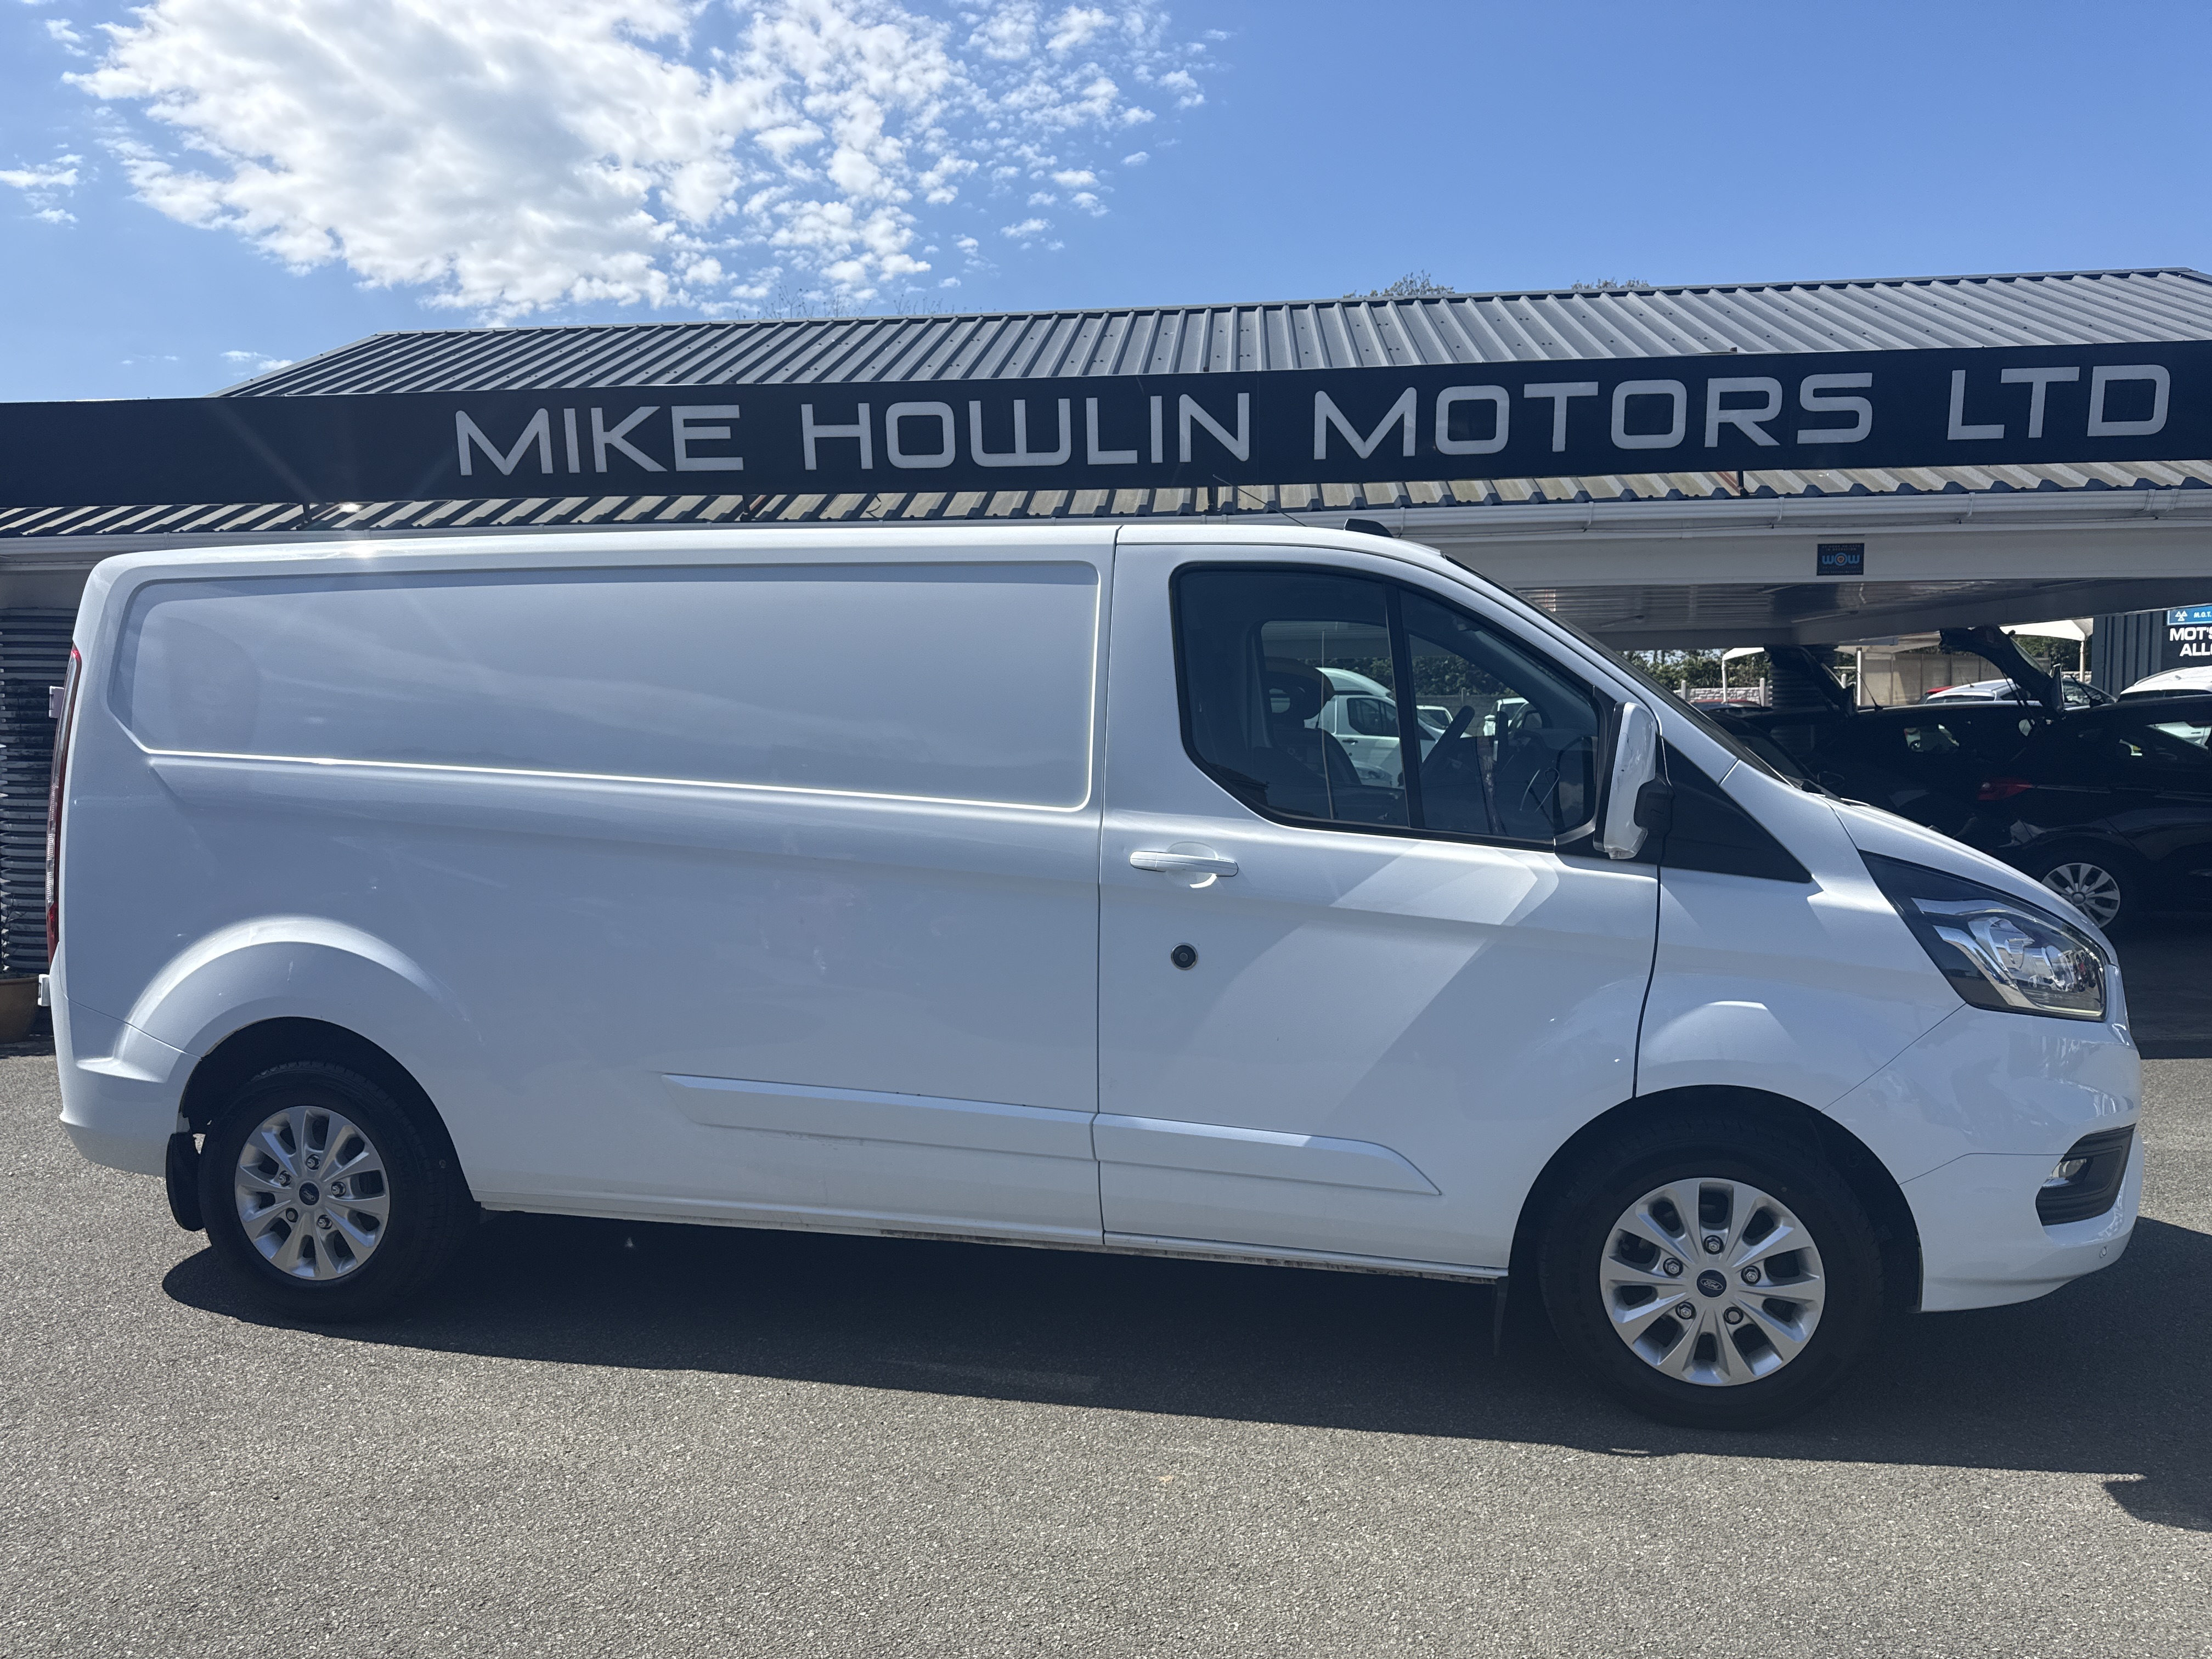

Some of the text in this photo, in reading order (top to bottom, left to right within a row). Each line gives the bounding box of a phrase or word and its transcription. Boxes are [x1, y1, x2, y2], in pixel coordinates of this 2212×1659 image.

[455, 364, 2171, 476] MIKE HOWLIN MOTORS LTD
[2179, 642, 2212, 657] ALL
